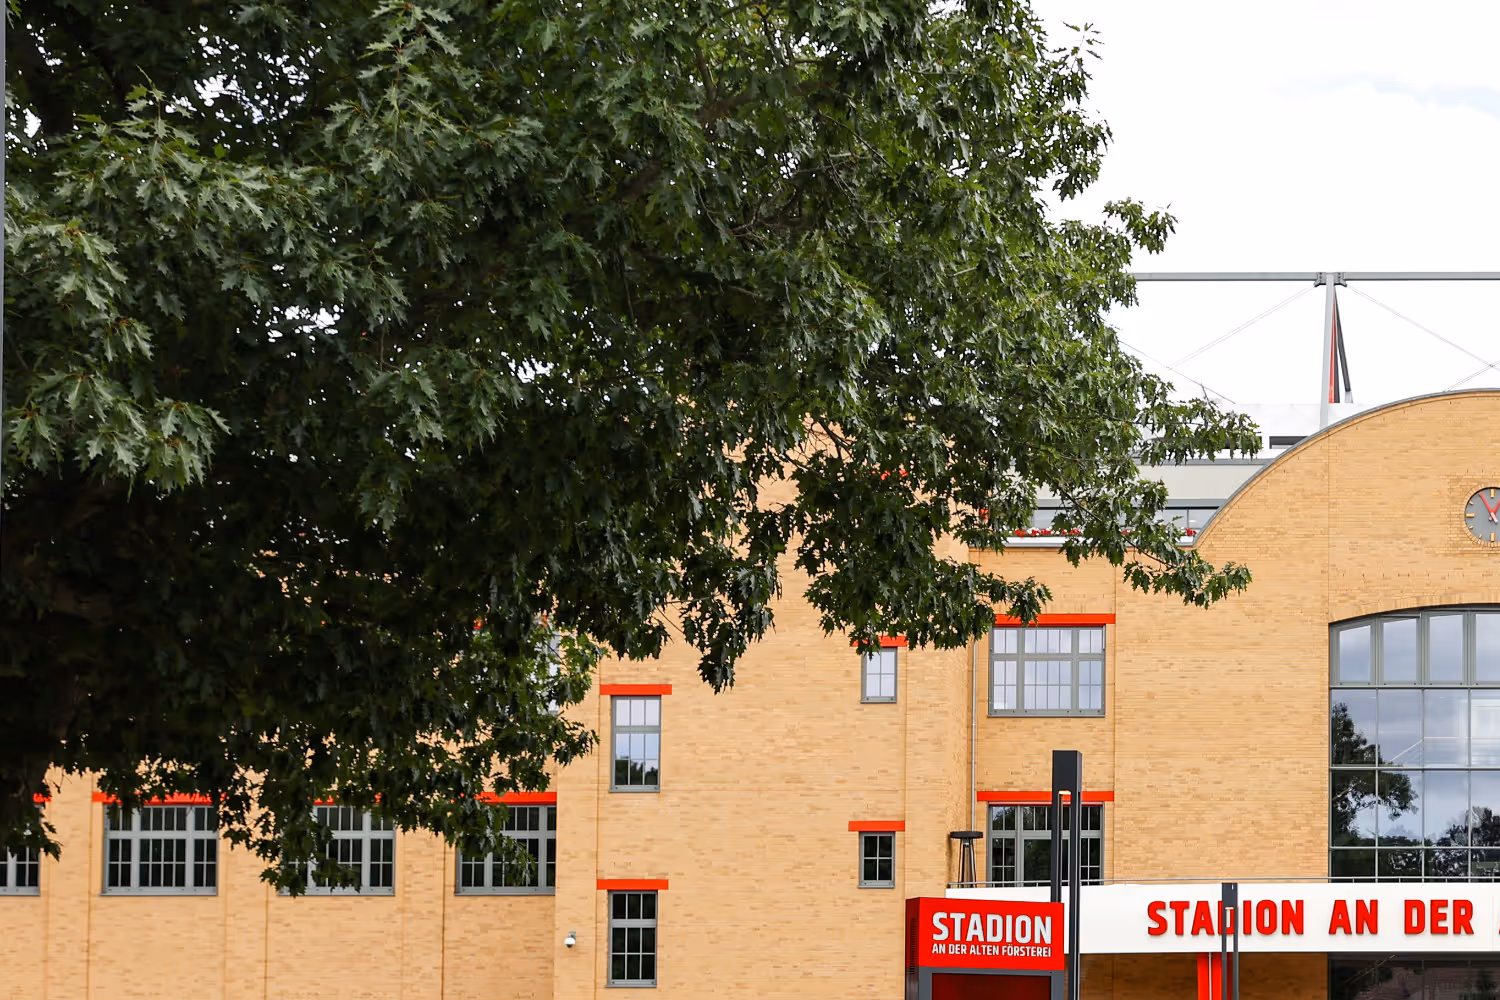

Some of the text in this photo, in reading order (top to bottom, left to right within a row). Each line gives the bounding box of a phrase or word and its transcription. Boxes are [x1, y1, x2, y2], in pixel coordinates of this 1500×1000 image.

[932, 911, 1052, 944] STADION
[1147, 899, 1304, 936] STADION
[1329, 899, 1378, 935] AN
[1404, 899, 1475, 935] DER
[932, 943, 1052, 957] AN DER ALTEN FÖRSTEREI
